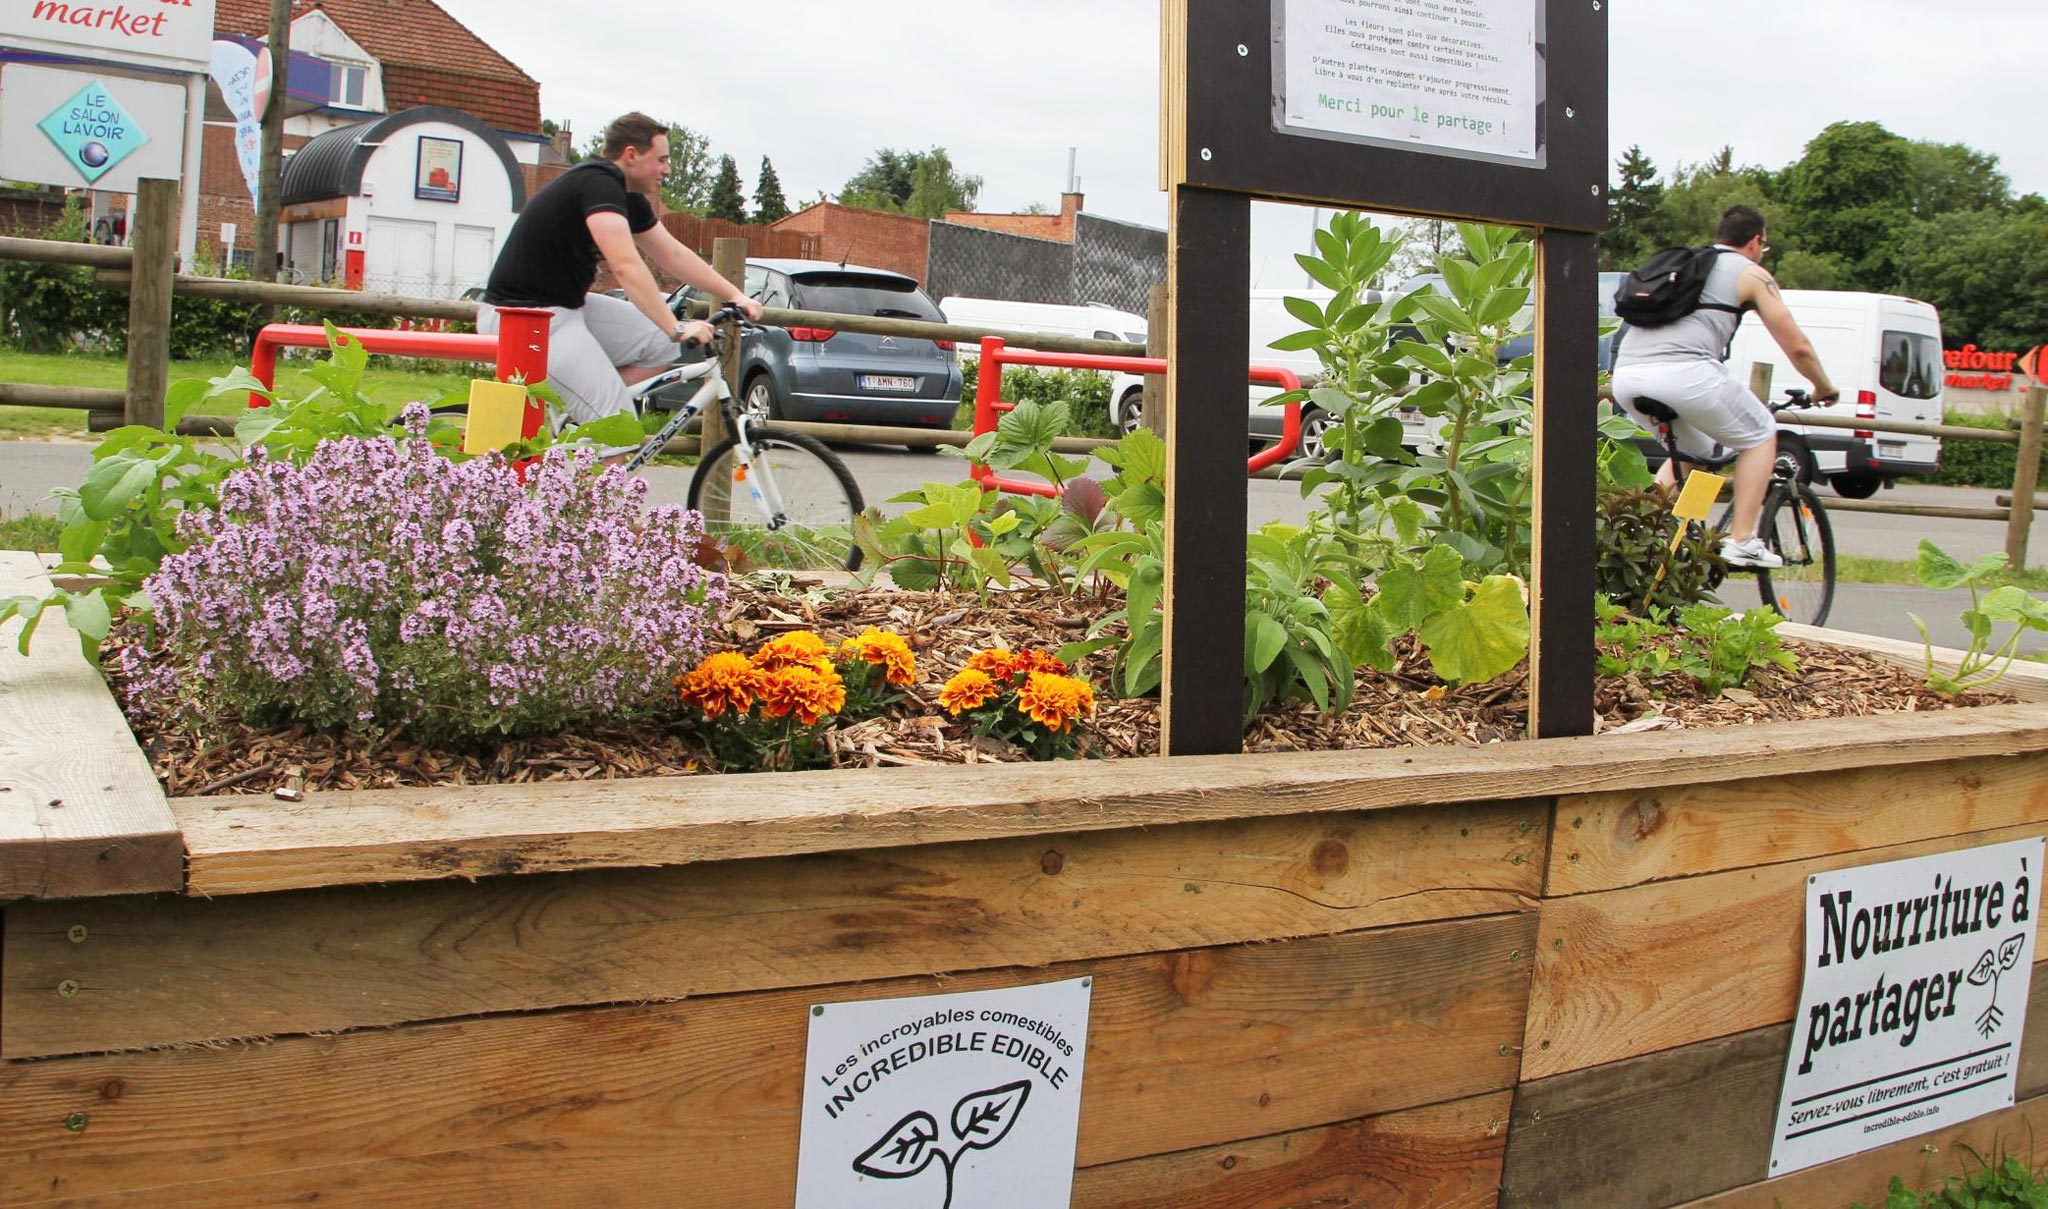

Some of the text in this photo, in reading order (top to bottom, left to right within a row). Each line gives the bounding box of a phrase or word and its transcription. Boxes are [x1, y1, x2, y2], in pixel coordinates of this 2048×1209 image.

[32, 1, 168, 37] market
[1345, 18, 1357, 27] Les
[1361, 20, 1384, 31] fleurs
[1388, 26, 1403, 34] sont
[1407, 29, 1422, 38] plus
[1426, 33, 1438, 42] que
[1394, 7, 1413, 15] ainsi
[1417, 11, 1450, 23] continuer
[1325, 25, 1346, 35] Elles
[1349, 30, 1365, 39] nous
[1369, 33, 1403, 45] protègent
[1407, 41, 1430, 50] contre
[1434, 45, 1463, 56] certains
[1351, 41, 1386, 53] Certaines
[1390, 48, 1405, 56] sont
[1409, 51, 1428, 60] aussi
[1432, 55, 1472, 68] comestibles
[1312, 56, 1345, 68] D'autres
[1349, 62, 1377, 73] plantes
[1380, 67, 1415, 80] viendront
[1419, 74, 1452, 85] s'ajouter
[1314, 67, 1336, 77] Libre
[1347, 73, 1363, 82] vous
[1366, 76, 1383, 85] d'en
[1386, 80, 1420, 91] replanter
[1424, 85, 1435, 93] une
[1439, 88, 1457, 97] après
[1461, 91, 1479, 100] votre
[71, 108, 119, 124] SALON
[86, 94, 105, 107] LE
[1318, 93, 1362, 113] Merci
[1371, 102, 1404, 119] pour
[1413, 105, 1429, 123] le
[1437, 112, 1493, 135] partage
[63, 121, 124, 140] LAVOIR
[1818, 857, 2030, 967] Nourriture à
[1798, 968, 1963, 1075] partager
[821, 1009, 1074, 1087] Les incroyables comestibles
[824, 1031, 1069, 1119] INCREDIBLE EDIBLE
[1788, 1095, 1865, 1127] Servez-vous
[1868, 1076, 1929, 1104] librement,
[1934, 1067, 1961, 1086] c'est
[1963, 1055, 2003, 1080] gratuit
[1864, 1105, 1940, 1133] incredible-edible.info
